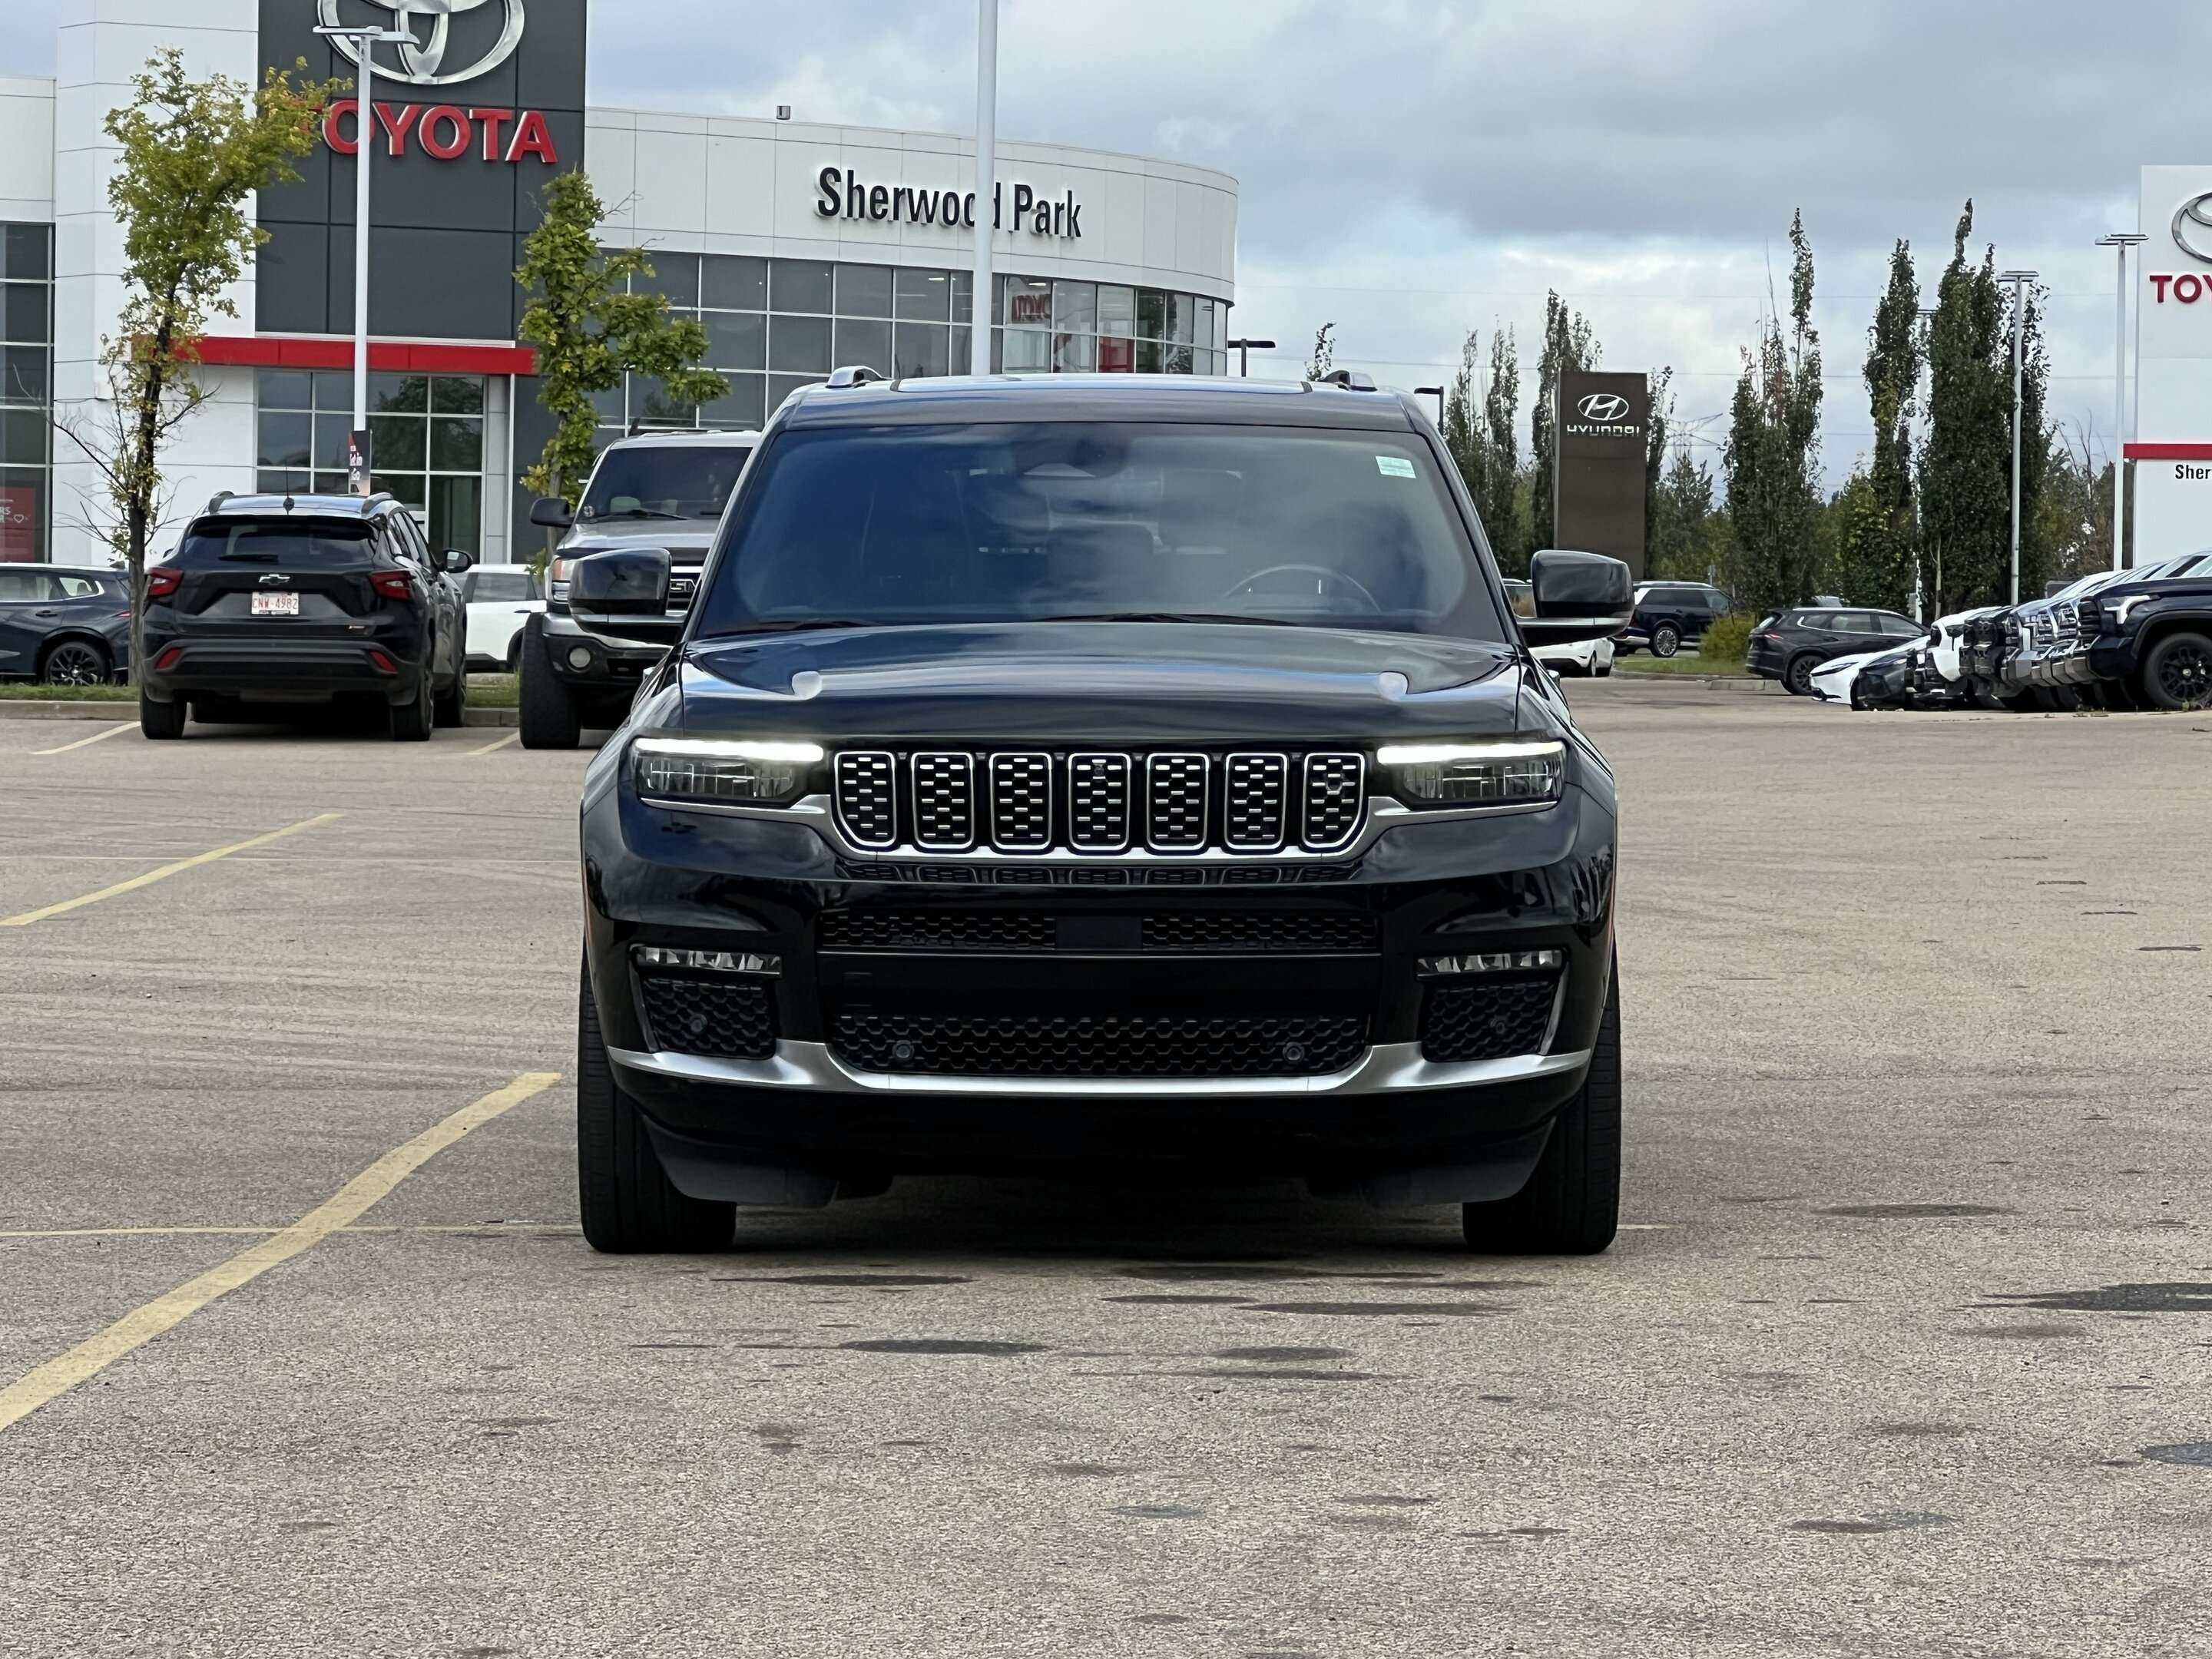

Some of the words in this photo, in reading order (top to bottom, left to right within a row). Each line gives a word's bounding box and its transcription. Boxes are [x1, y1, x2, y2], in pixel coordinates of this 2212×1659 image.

[300, 99, 558, 163] OYOTA
[1014, 184, 1081, 238] Park
[1567, 424, 1640, 437] HYUNDAI
